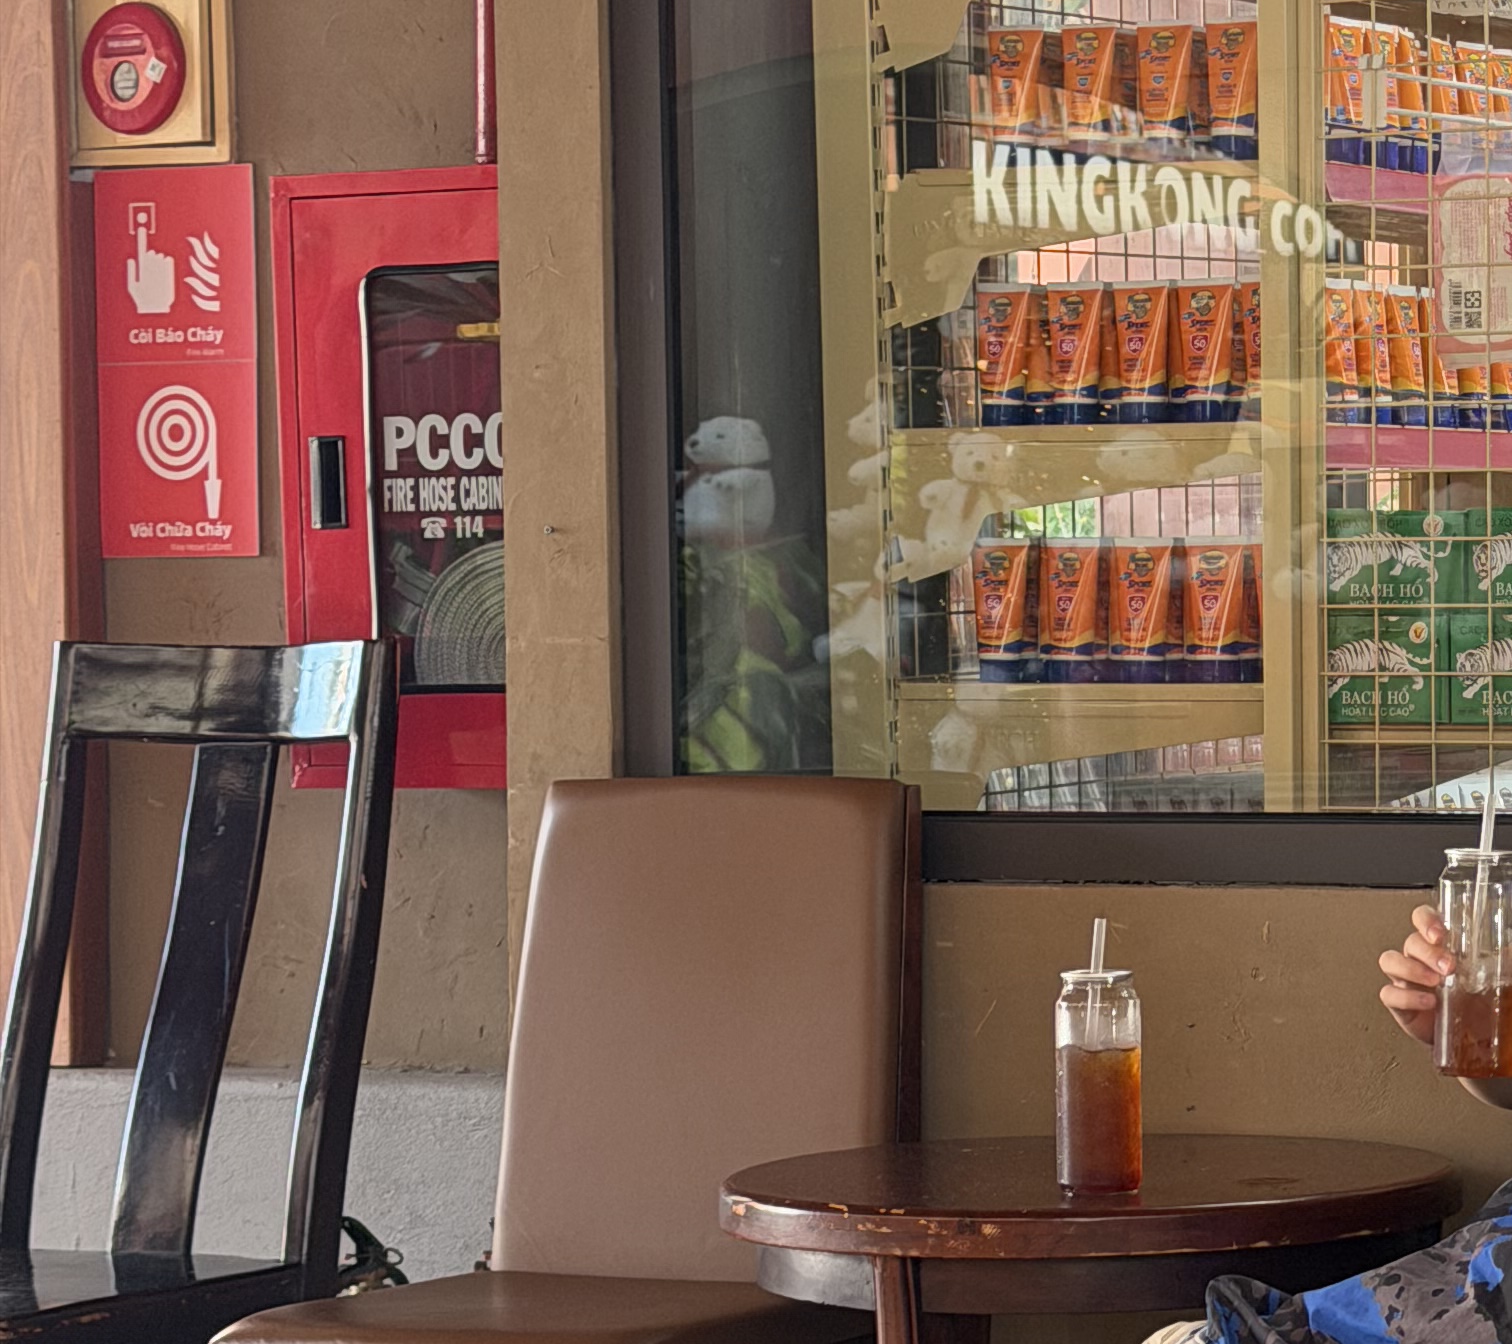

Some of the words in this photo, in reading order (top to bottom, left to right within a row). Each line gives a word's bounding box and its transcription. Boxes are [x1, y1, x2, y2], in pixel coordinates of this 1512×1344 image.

[129, 328, 153, 344] Còi
[156, 327, 185, 343] Báo
[187, 326, 224, 344] Cháy
[383, 477, 416, 513] FIRE
[419, 476, 457, 512] HOSE
[196, 520, 232, 540] Cháy
[453, 515, 485, 539] 114
